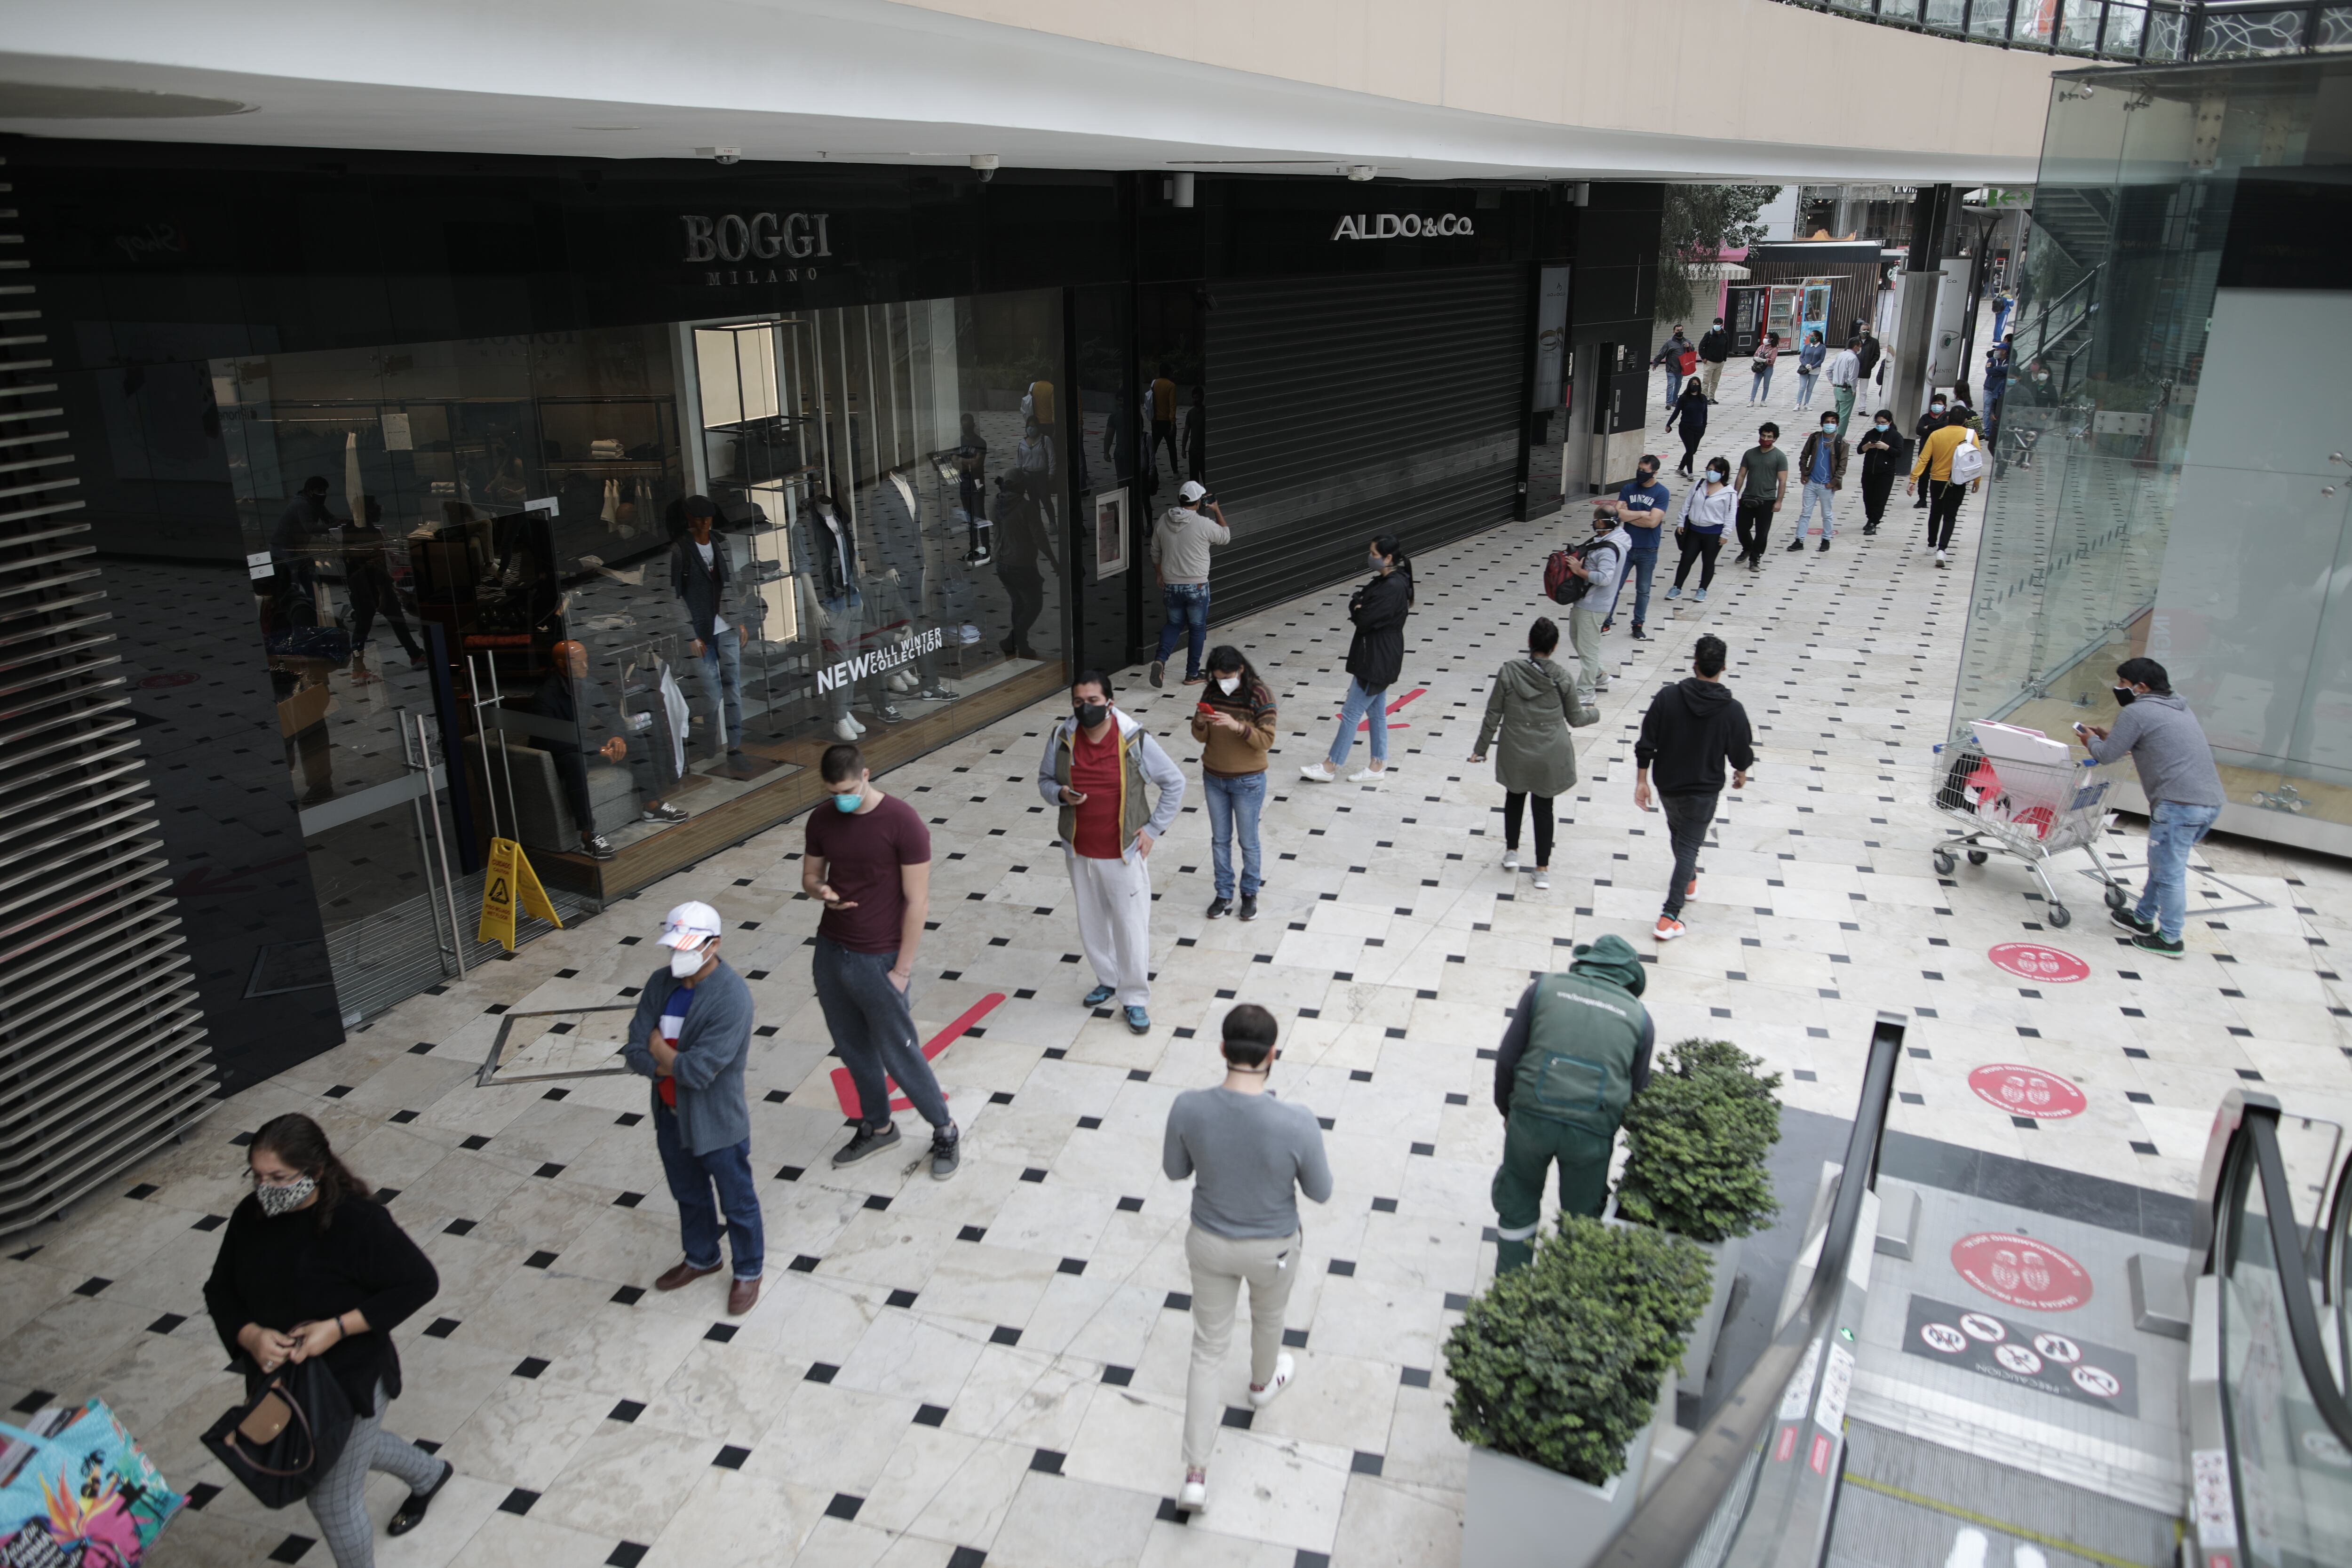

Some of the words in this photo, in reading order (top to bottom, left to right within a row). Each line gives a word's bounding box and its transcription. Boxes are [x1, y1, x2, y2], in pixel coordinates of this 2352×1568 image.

[680, 212, 832, 262] BOGGI
[706, 268, 817, 286] MILANO
[817, 653, 870, 694] NEW
[871, 637, 942, 674] COLLECTION
[870, 645, 898, 663] FALL
[900, 627, 941, 651] WINTER
